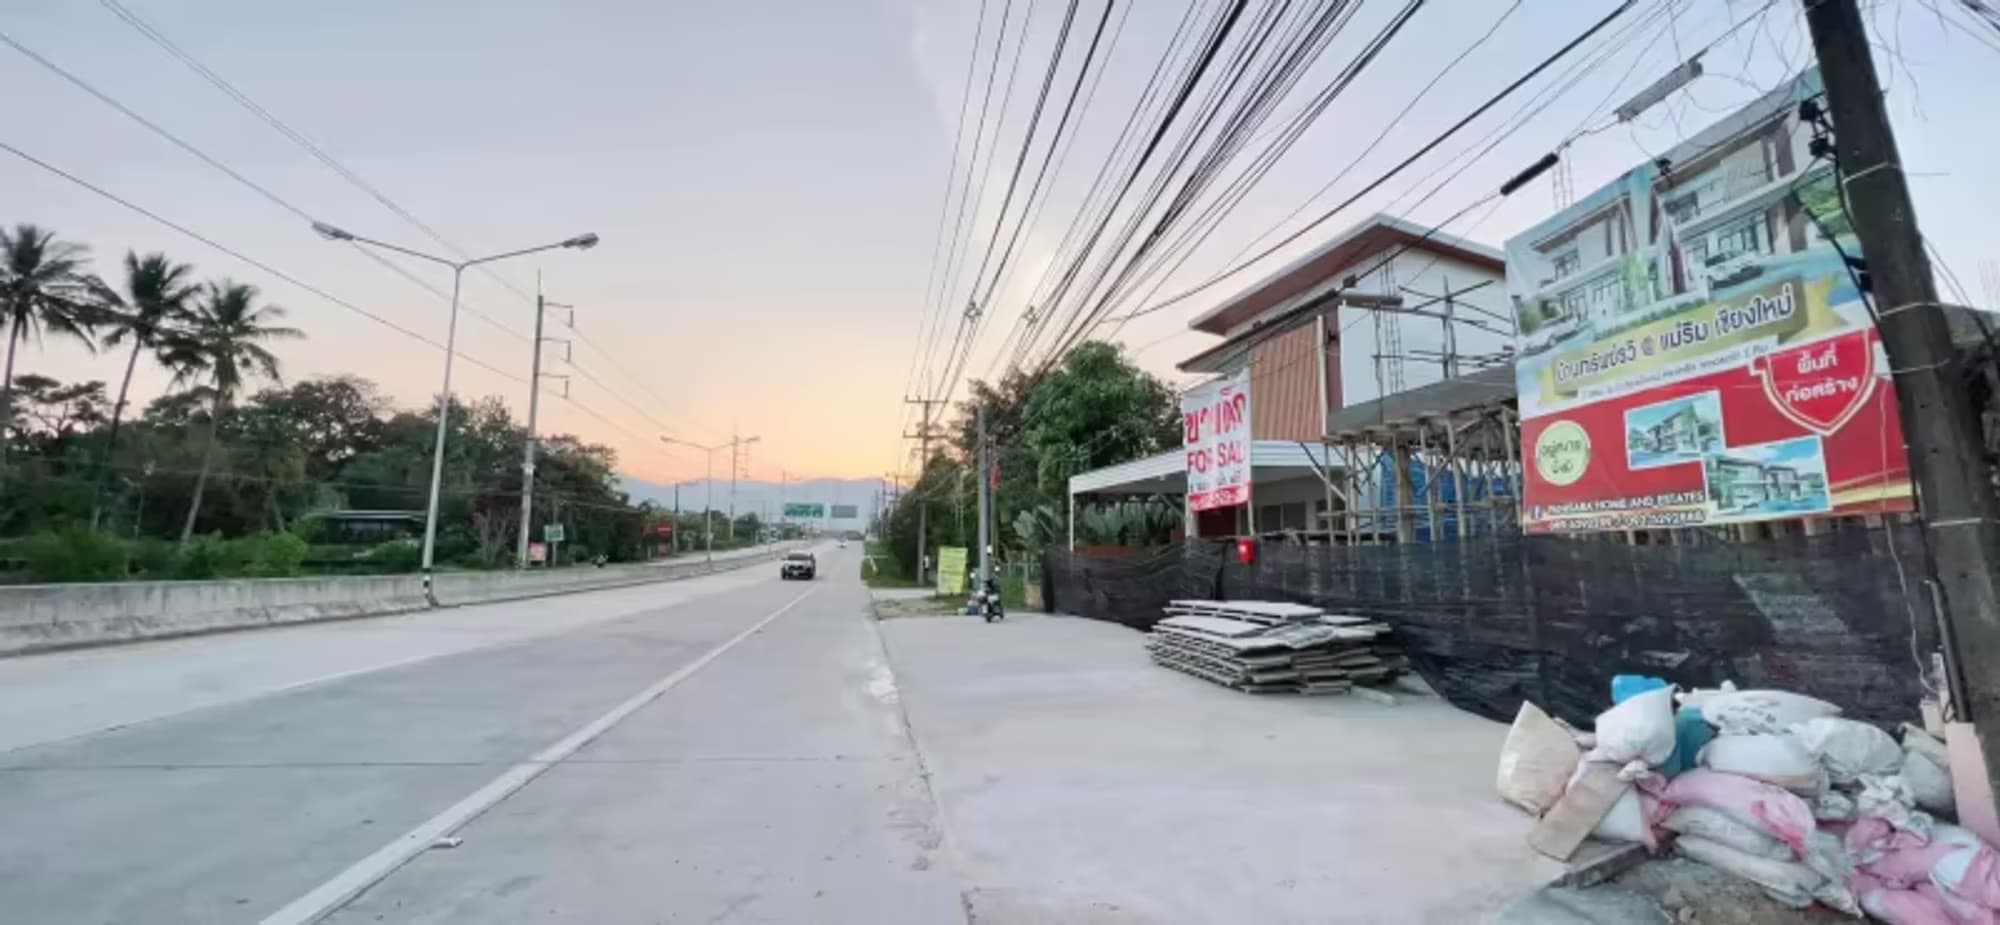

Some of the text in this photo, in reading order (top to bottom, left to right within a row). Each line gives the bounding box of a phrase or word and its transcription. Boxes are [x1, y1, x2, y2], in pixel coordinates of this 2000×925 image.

[1660, 319, 1709, 351] แม่ริม
[1714, 281, 1794, 335] เชียงใหม่
[1785, 376, 1860, 403] ก่อสร้าง
[1631, 496, 1655, 509] AND
